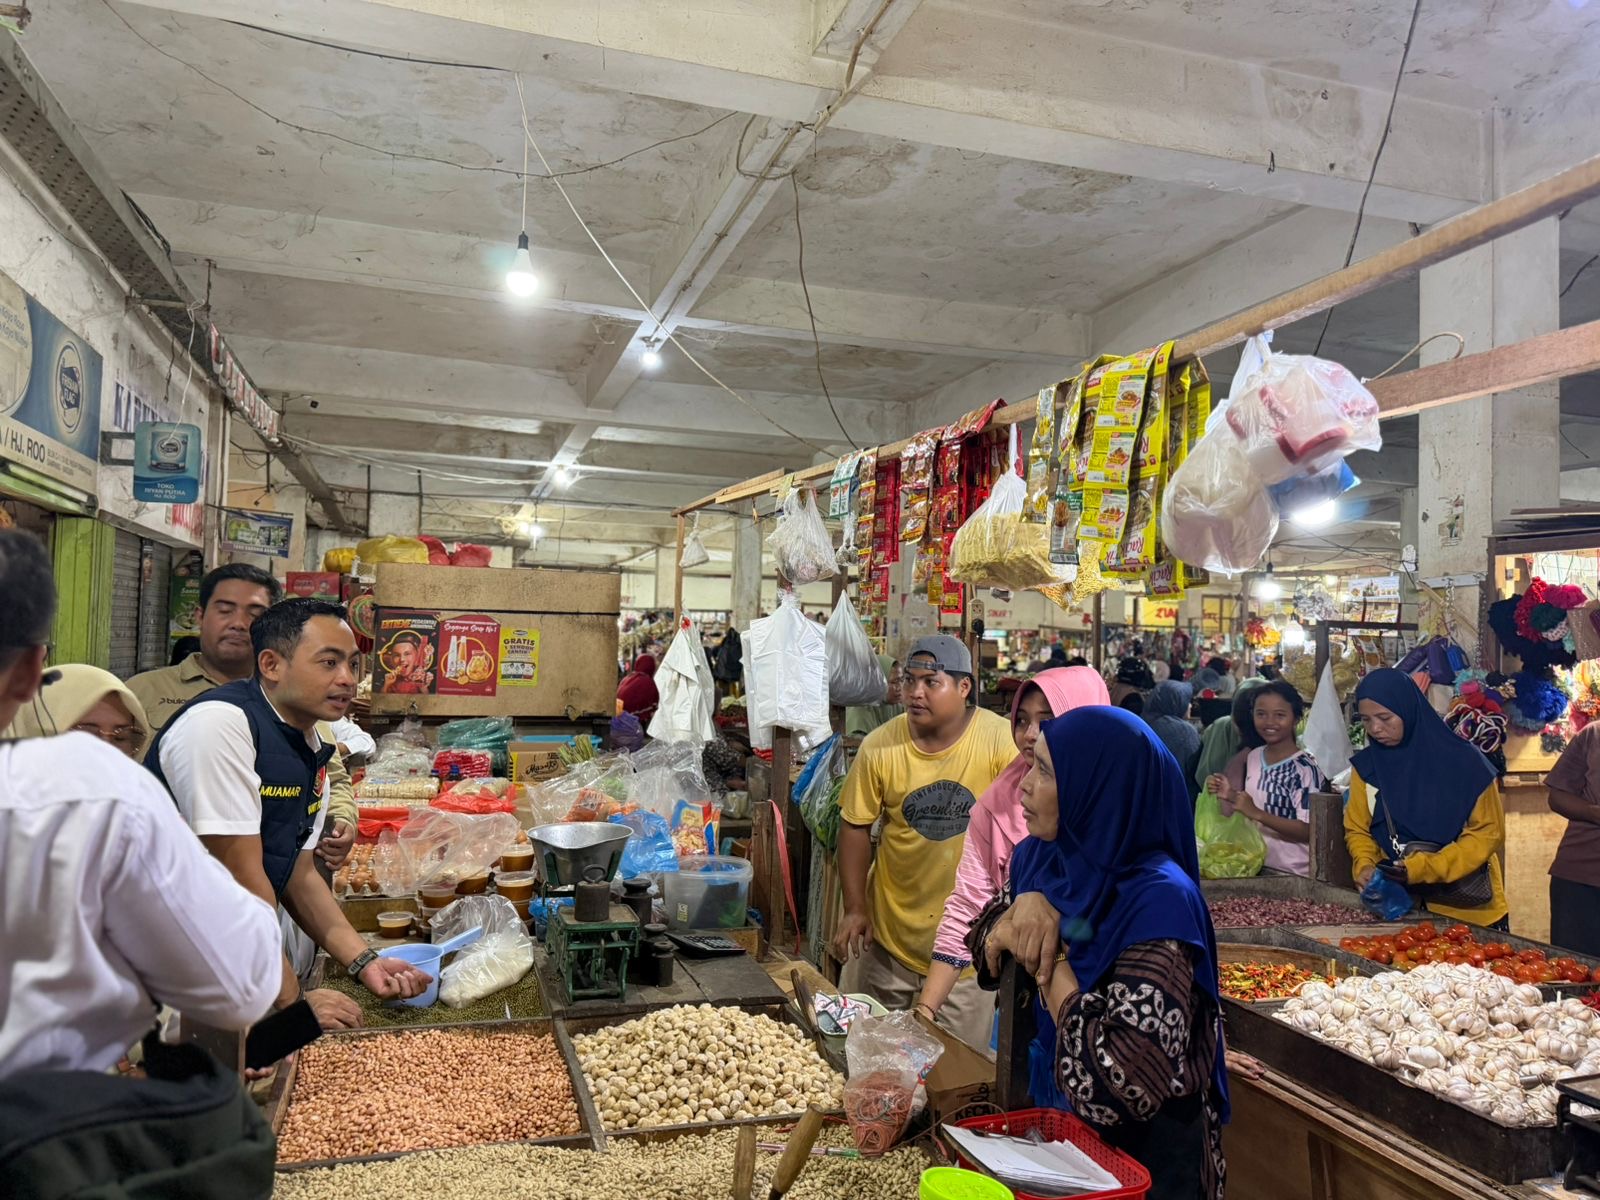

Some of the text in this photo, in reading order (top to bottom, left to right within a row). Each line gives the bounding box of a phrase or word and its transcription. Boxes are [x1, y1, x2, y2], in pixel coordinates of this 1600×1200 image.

[27, 438, 45, 463] ROO
[382, 619, 411, 629] EXTREME
[503, 638, 535, 646] GRATIS
[260, 785, 301, 797] MUAMAR
